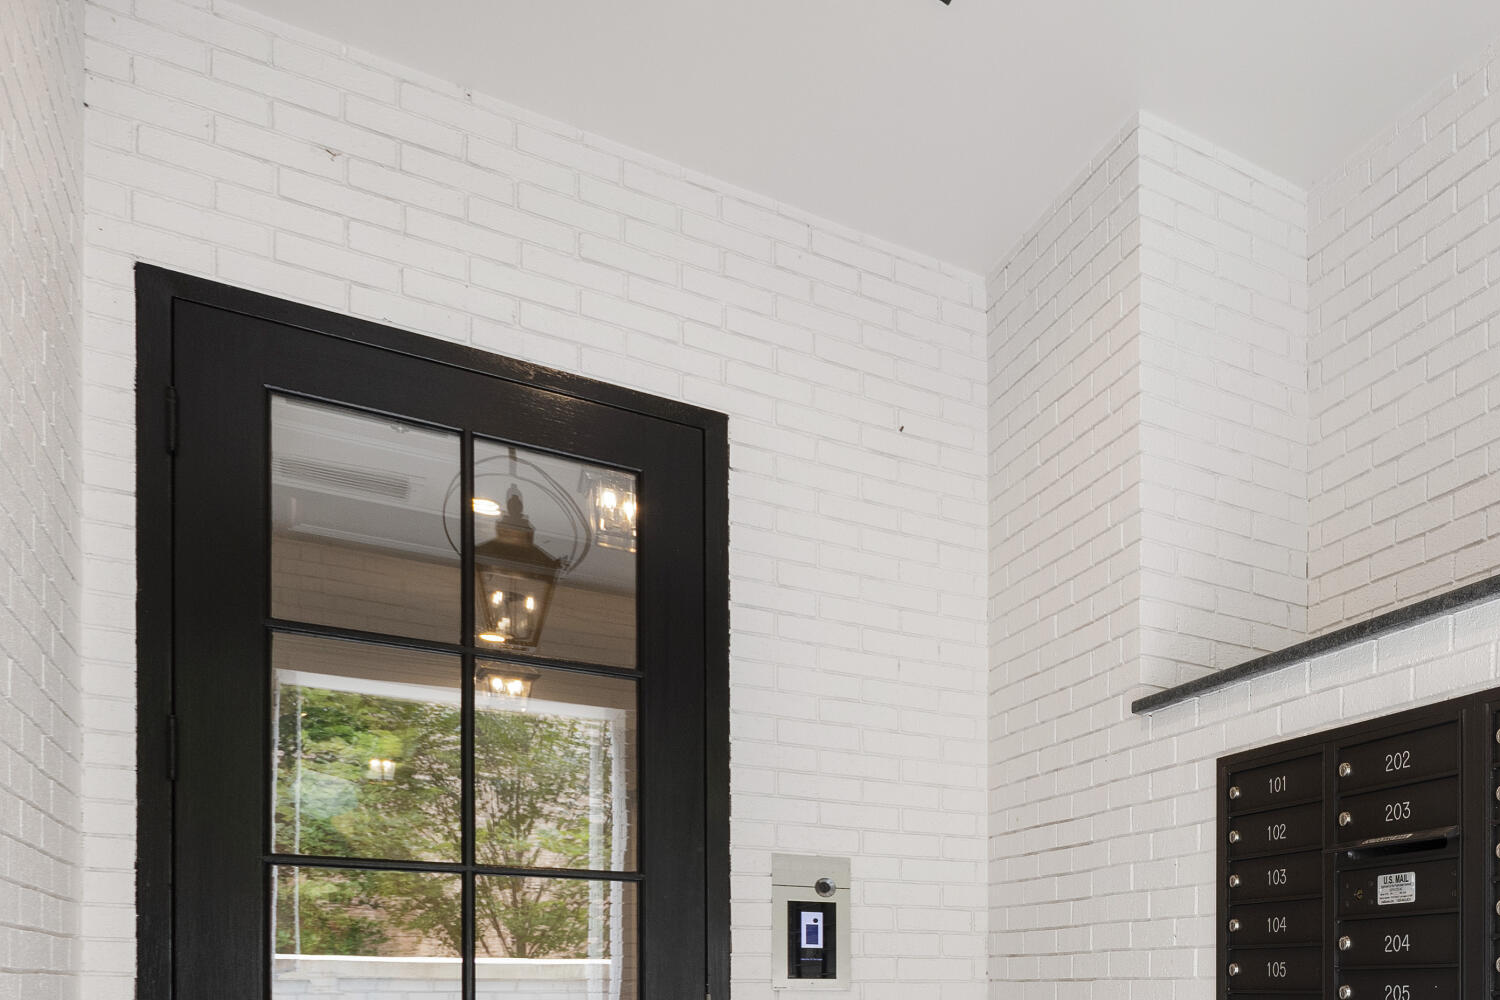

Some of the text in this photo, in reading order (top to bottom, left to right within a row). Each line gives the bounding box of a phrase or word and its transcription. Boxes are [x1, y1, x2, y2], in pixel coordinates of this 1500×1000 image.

[1385, 750, 1411, 772] 202
[1268, 775, 1286, 794] 101
[1385, 801, 1411, 822] 203
[1267, 823, 1287, 841] 102
[1267, 868, 1287, 886] 103
[1267, 916, 1287, 933] 104
[1384, 934, 1411, 953] 204
[1267, 961, 1287, 978] 105
